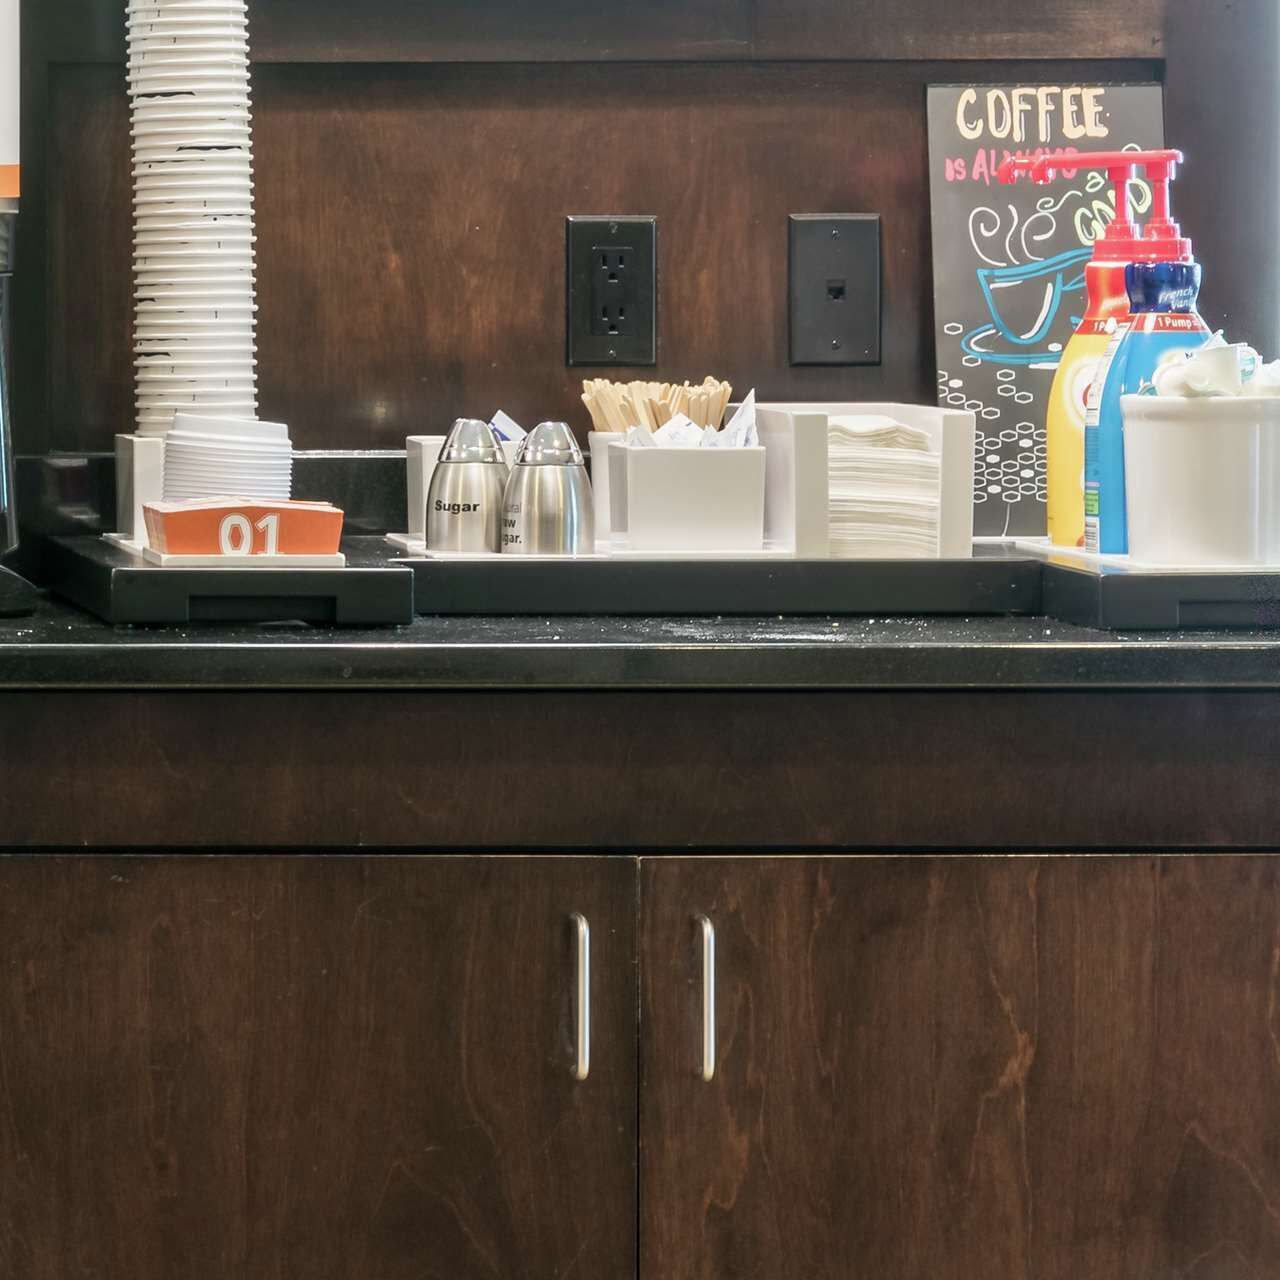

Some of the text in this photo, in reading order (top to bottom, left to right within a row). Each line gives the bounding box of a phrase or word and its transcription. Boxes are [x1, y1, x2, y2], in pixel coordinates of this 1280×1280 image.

[956, 87, 1109, 143] COFFEE
[1165, 317, 1192, 329] Pump
[435, 500, 480, 514] Sugar
[219, 513, 283, 556] 01
